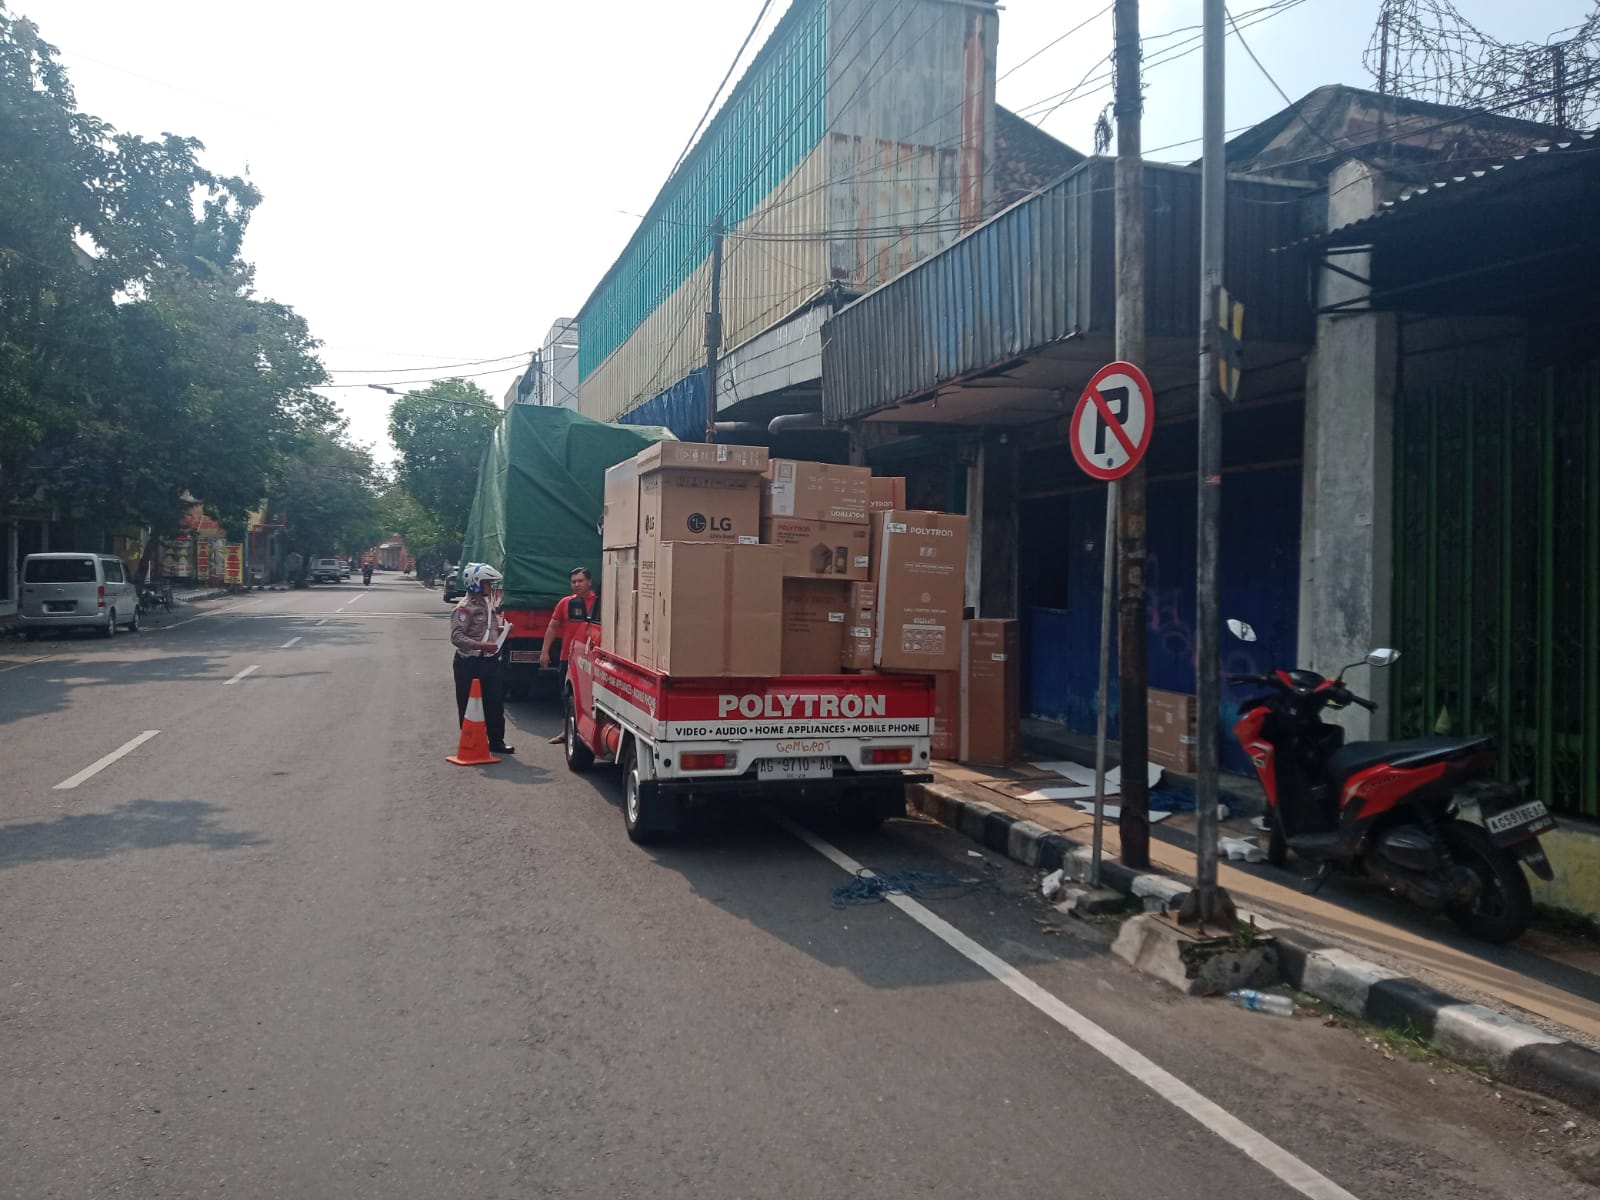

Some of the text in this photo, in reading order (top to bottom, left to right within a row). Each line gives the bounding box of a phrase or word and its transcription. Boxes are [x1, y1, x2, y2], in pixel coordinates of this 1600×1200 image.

[1094, 386, 1130, 455] P
[869, 500, 893, 508] YTRON
[710, 517, 732, 531] LG
[910, 527, 953, 537] POLYTRON
[718, 694, 886, 718] POLYTRON
[675, 723, 921, 737] VIDEO AUDIO HOME APPLIANCES MOBILE PHONE
[760, 760, 773, 773] AG
